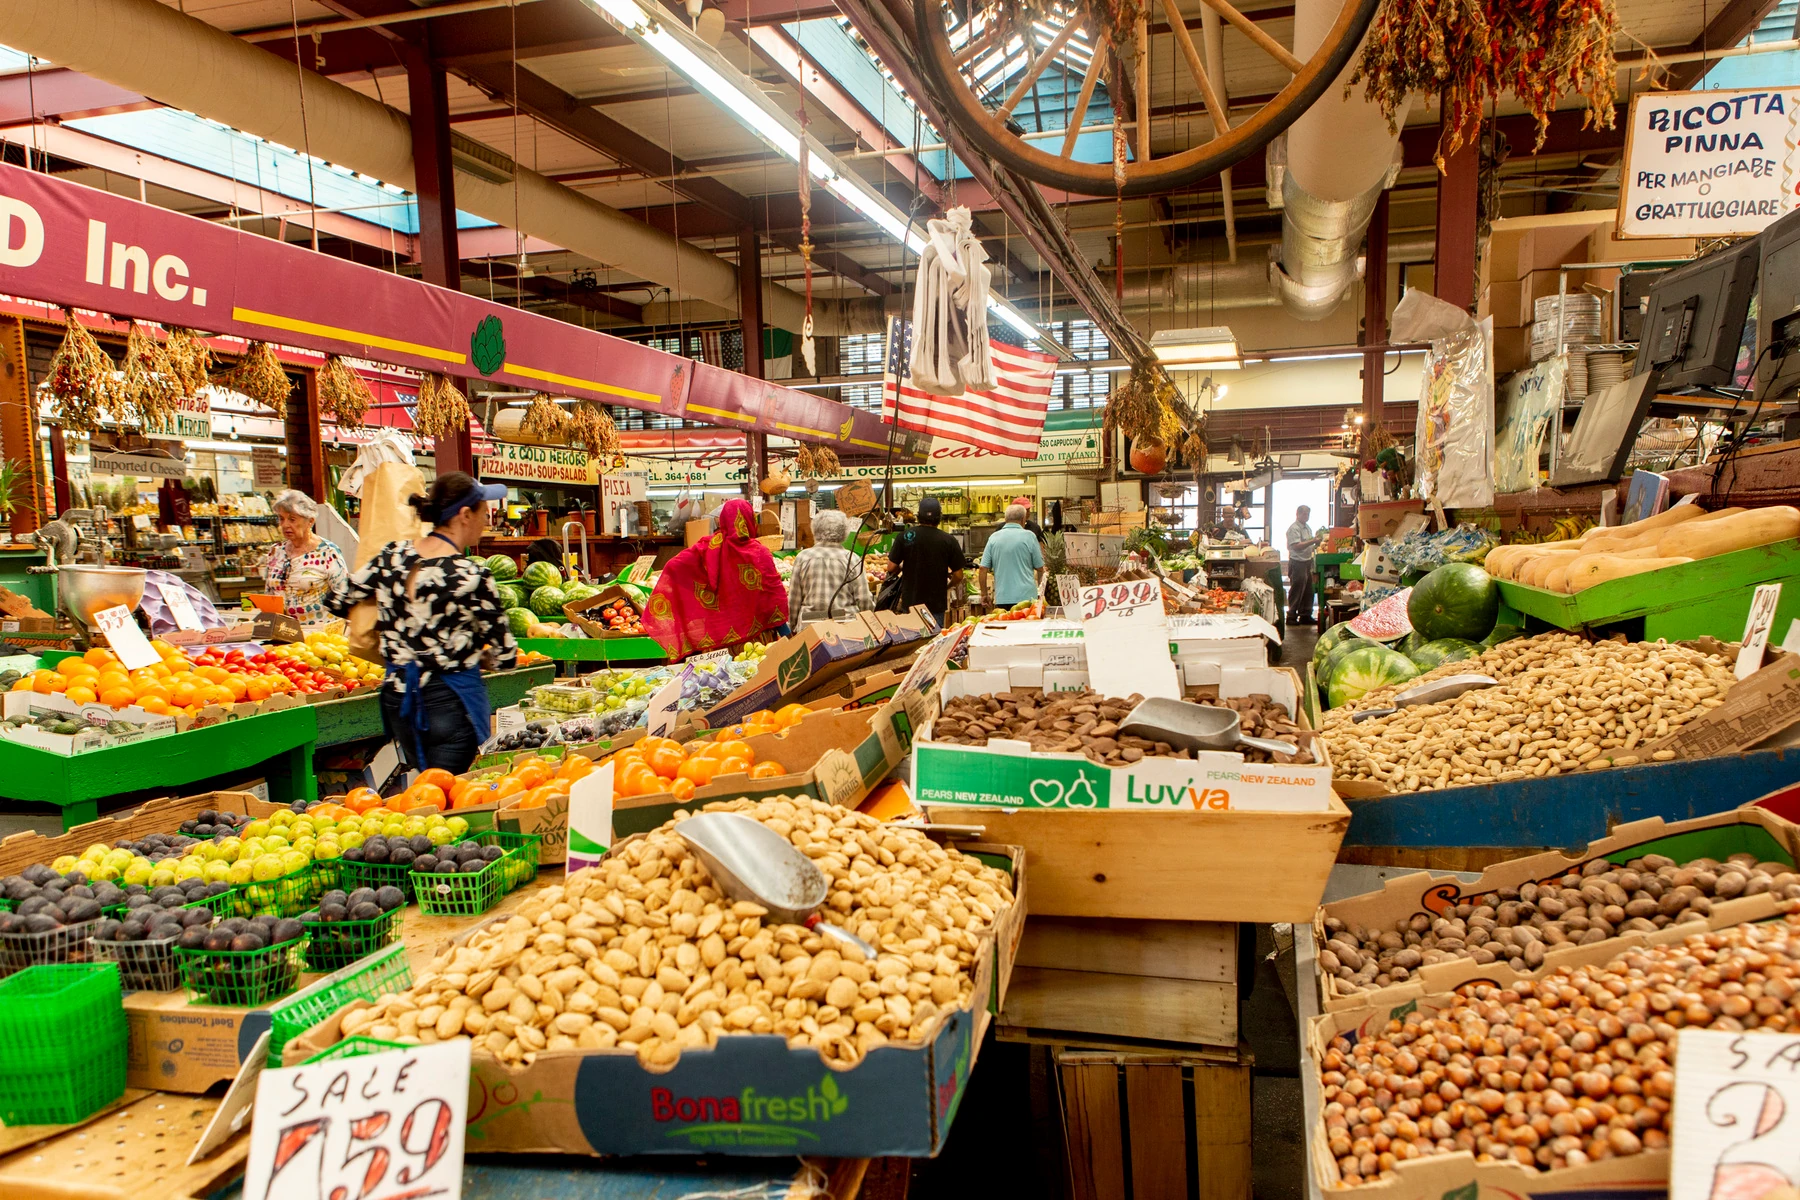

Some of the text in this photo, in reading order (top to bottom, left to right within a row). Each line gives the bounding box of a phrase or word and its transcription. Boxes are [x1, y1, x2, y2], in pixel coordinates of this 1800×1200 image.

[1649, 93, 1784, 132] RICOTTA
[1665, 132, 1764, 153] PINNA
[1637, 157, 1776, 189] PER MANGIARE
[1636, 200, 1779, 221] GRATTUGGIARE
[86, 218, 207, 307] Inc.
[1050, 438, 1082, 447] CAPPUCCINO
[520, 446, 546, 462] COLD
[1058, 451, 1096, 460] ITALIANO
[93, 458, 185, 476] Imported Cheeses
[481, 460, 587, 481] PIZZA PASTA SOUP SALADS
[648, 473, 662, 481] EL.
[1118, 608, 1134, 617] LB
[1206, 771, 1316, 787] PEARS NEW ZEALAND
[921, 788, 1025, 806] PEARS NEW ZEALAND
[160, 1015, 234, 1028] Beef Tomatoes
[281, 1058, 418, 1117] SALE
[651, 1086, 831, 1122] Bonafresh
